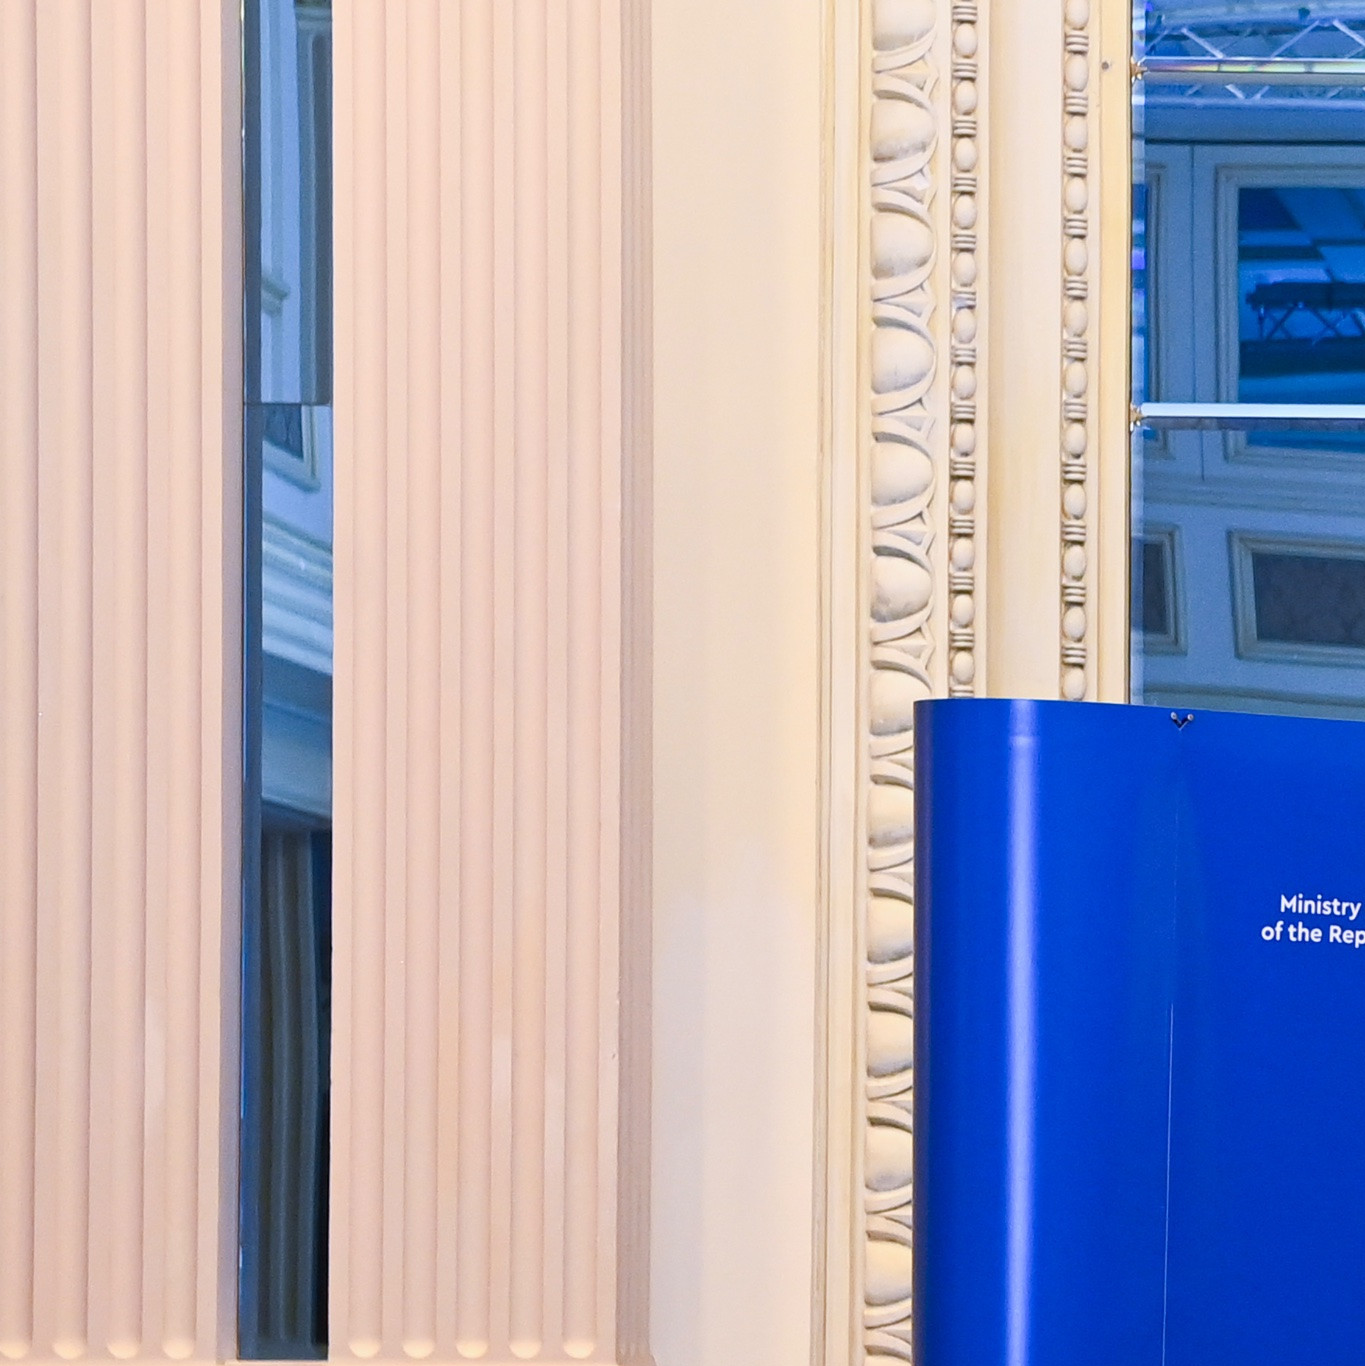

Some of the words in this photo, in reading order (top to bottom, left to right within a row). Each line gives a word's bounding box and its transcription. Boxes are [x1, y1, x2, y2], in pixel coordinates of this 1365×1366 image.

[1279, 894, 1362, 921] Ministry
[1261, 920, 1284, 941] of
[1287, 921, 1323, 943] the
